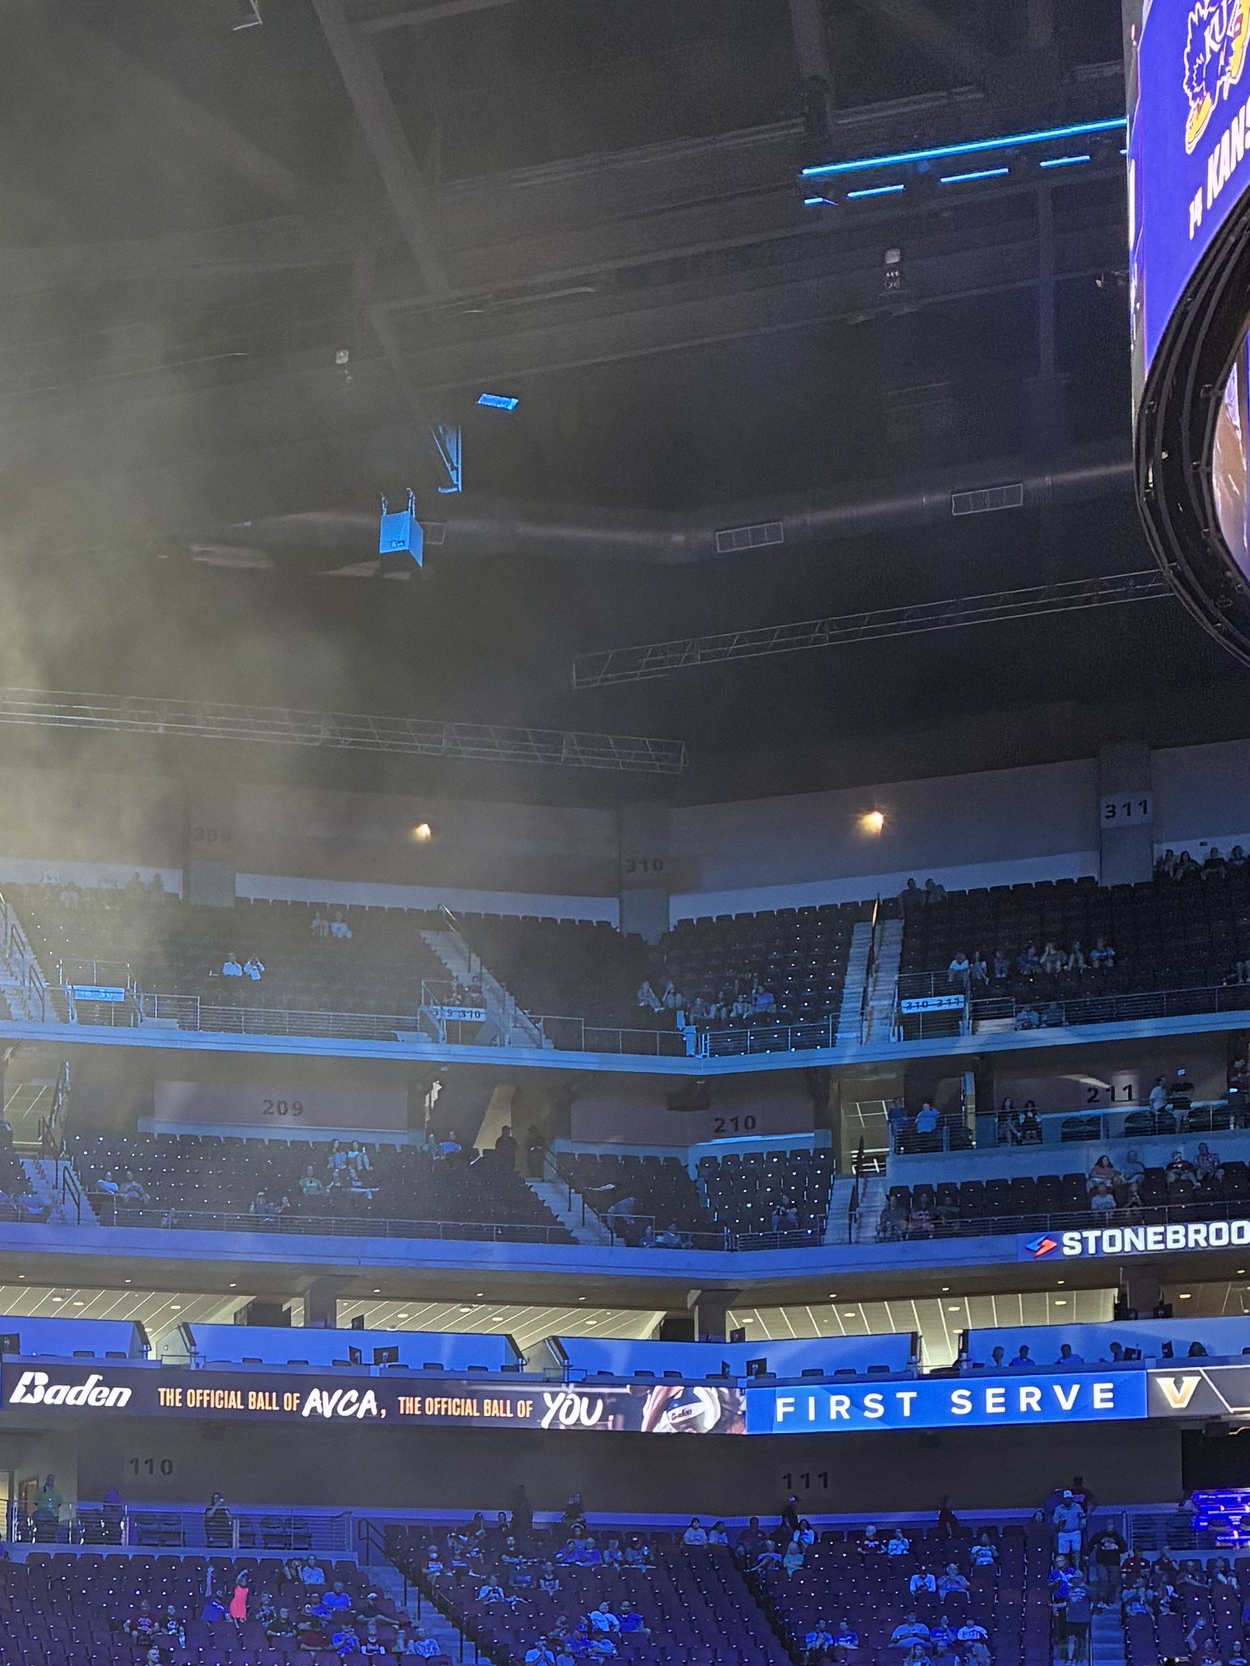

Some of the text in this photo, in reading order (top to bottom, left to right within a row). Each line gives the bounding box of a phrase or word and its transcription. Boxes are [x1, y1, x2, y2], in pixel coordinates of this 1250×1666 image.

[1105, 799, 1148, 819] 311
[625, 857, 664, 874] 310
[1086, 1083, 1133, 1103] 211
[261, 1098, 304, 1117] 209
[714, 1115, 756, 1134] 210
[9, 1372, 132, 1408] Baden
[157, 1387, 183, 1408] THE
[186, 1389, 245, 1410] OFFICIAL
[248, 1390, 280, 1411] BALL
[283, 1392, 301, 1412] OF
[1156, 1376, 1201, 1409] V
[398, 1397, 422, 1415] THE
[425, 1397, 481, 1417] OFFICIAL
[483, 1398, 514, 1418] BALL
[516, 1399, 534, 1418] OF
[775, 1383, 1115, 1422] FIRST SERVE
[130, 1457, 174, 1476] 110
[782, 1471, 830, 1491] 111
